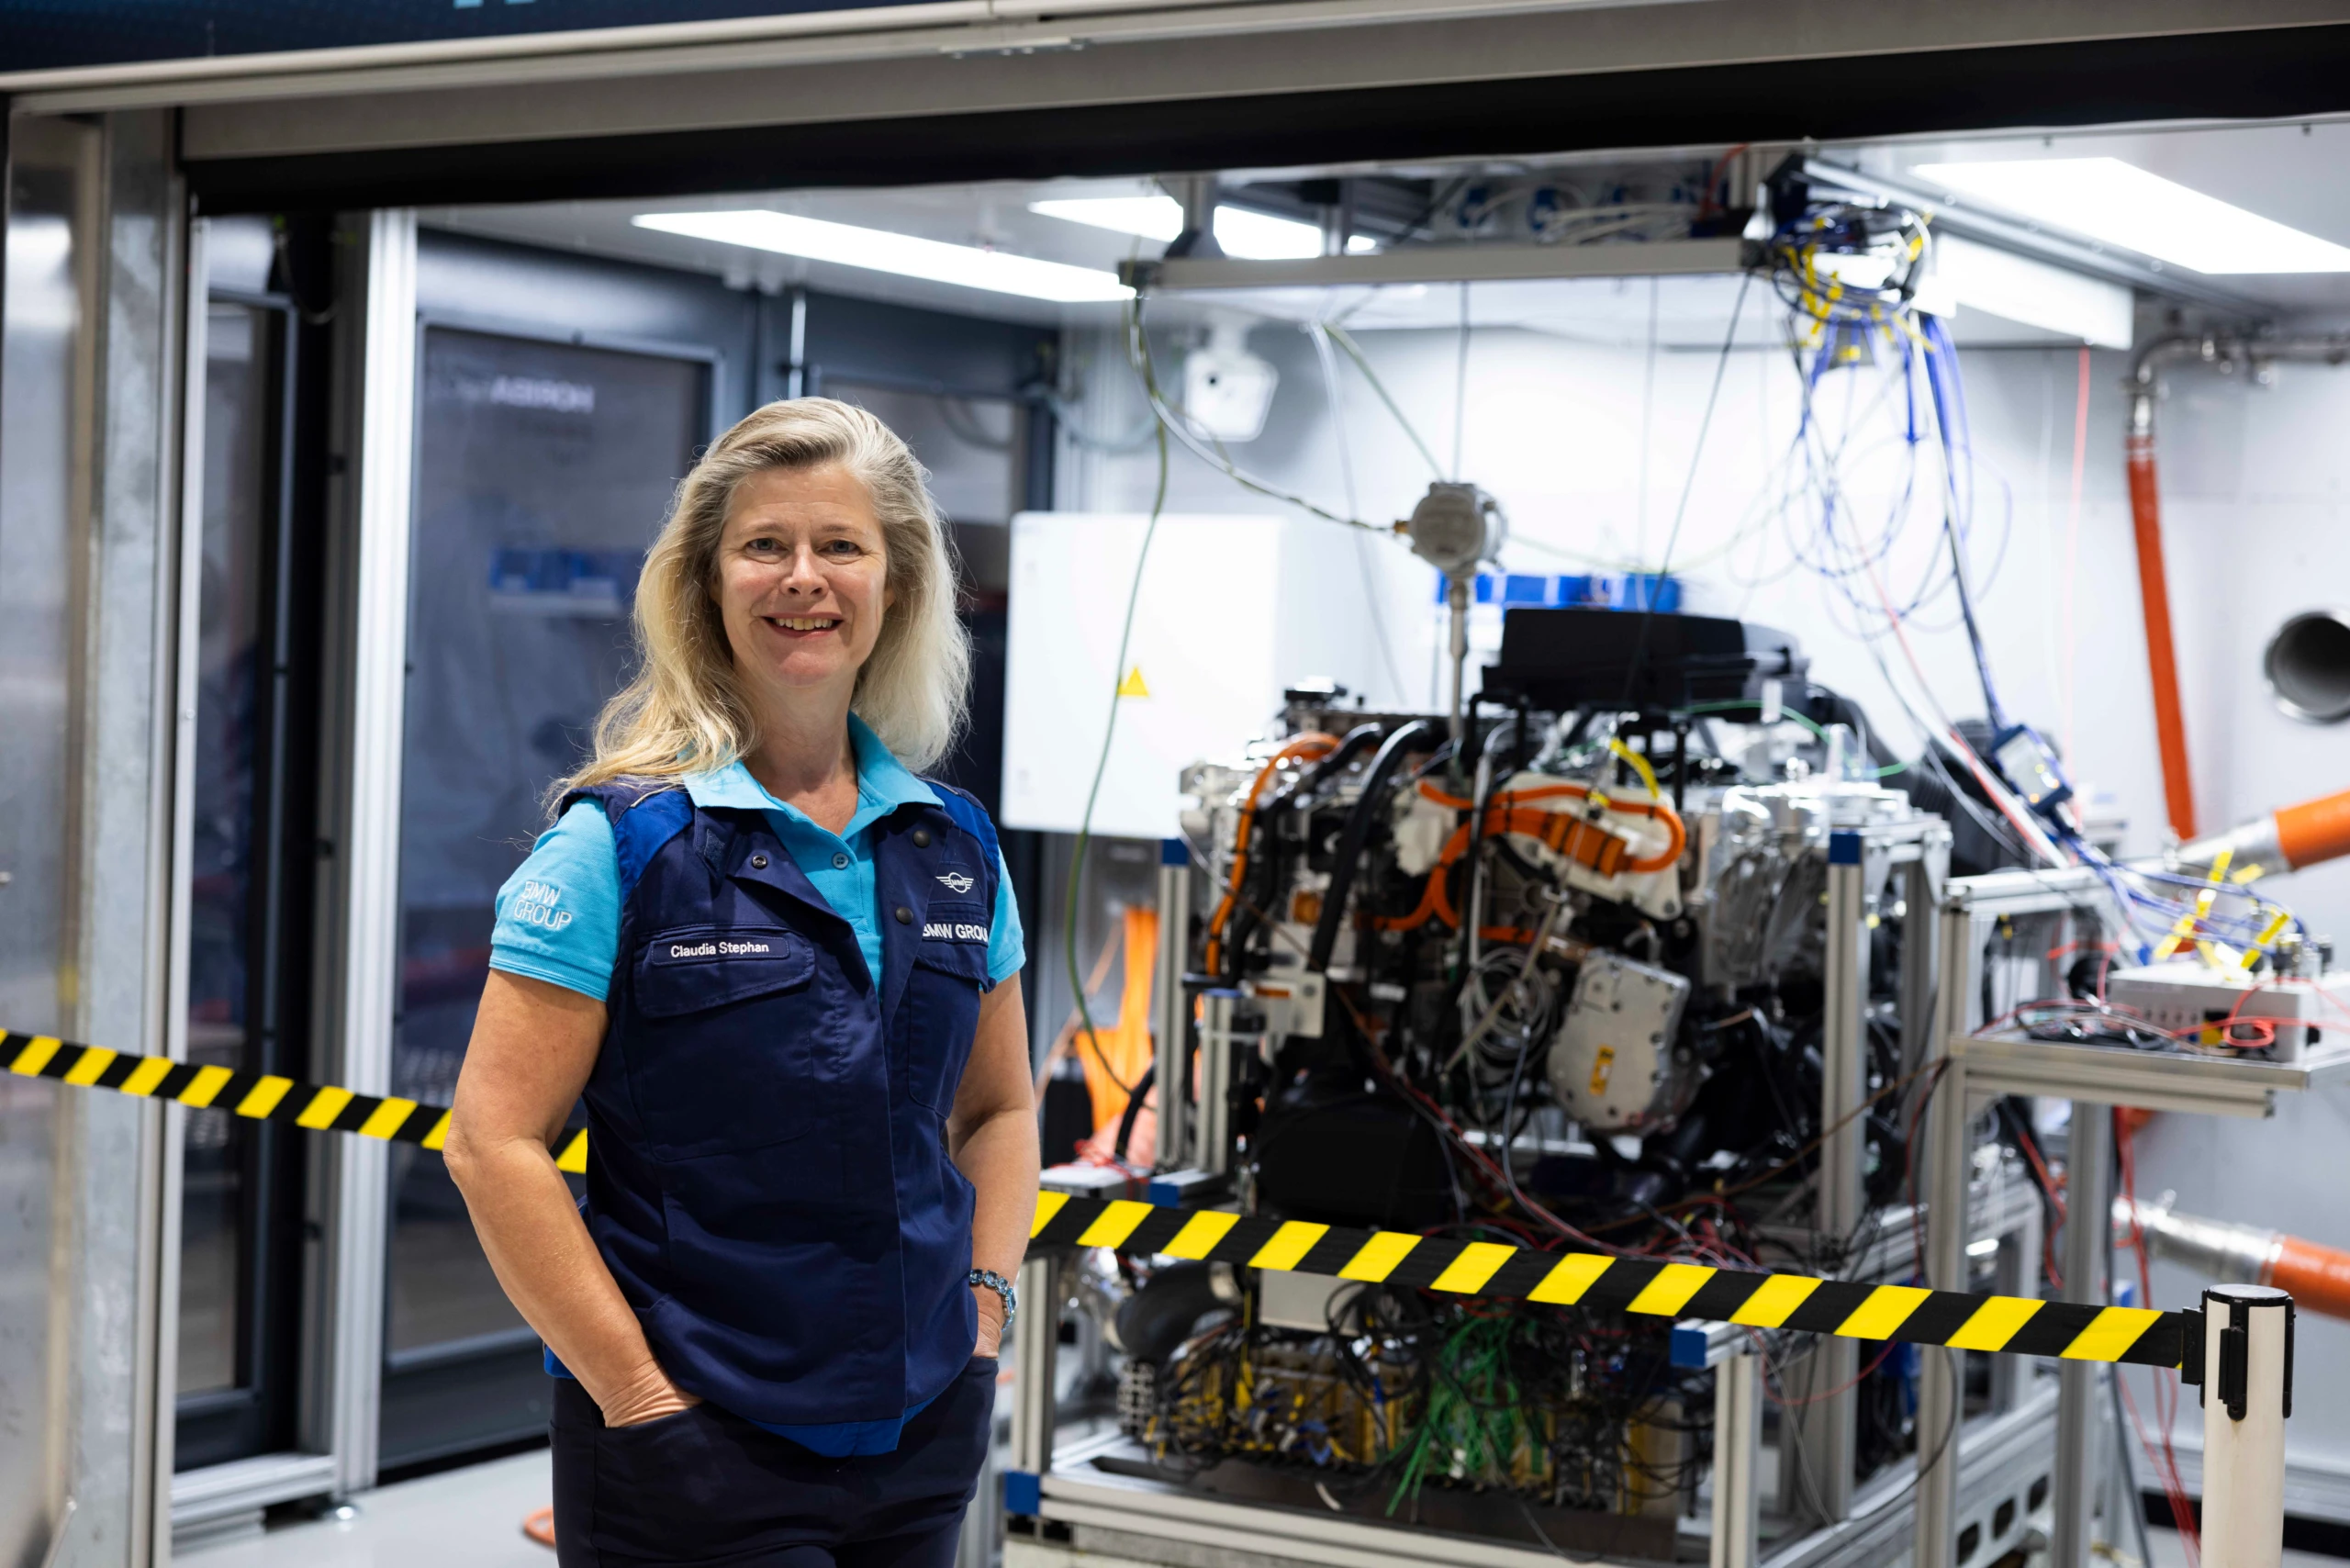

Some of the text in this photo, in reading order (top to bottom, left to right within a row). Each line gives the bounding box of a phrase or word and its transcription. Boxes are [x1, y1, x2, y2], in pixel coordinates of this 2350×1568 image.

[521, 880, 561, 907] BMW
[514, 900, 572, 930] GROUP
[670, 941, 769, 958] Claudia Stephan
